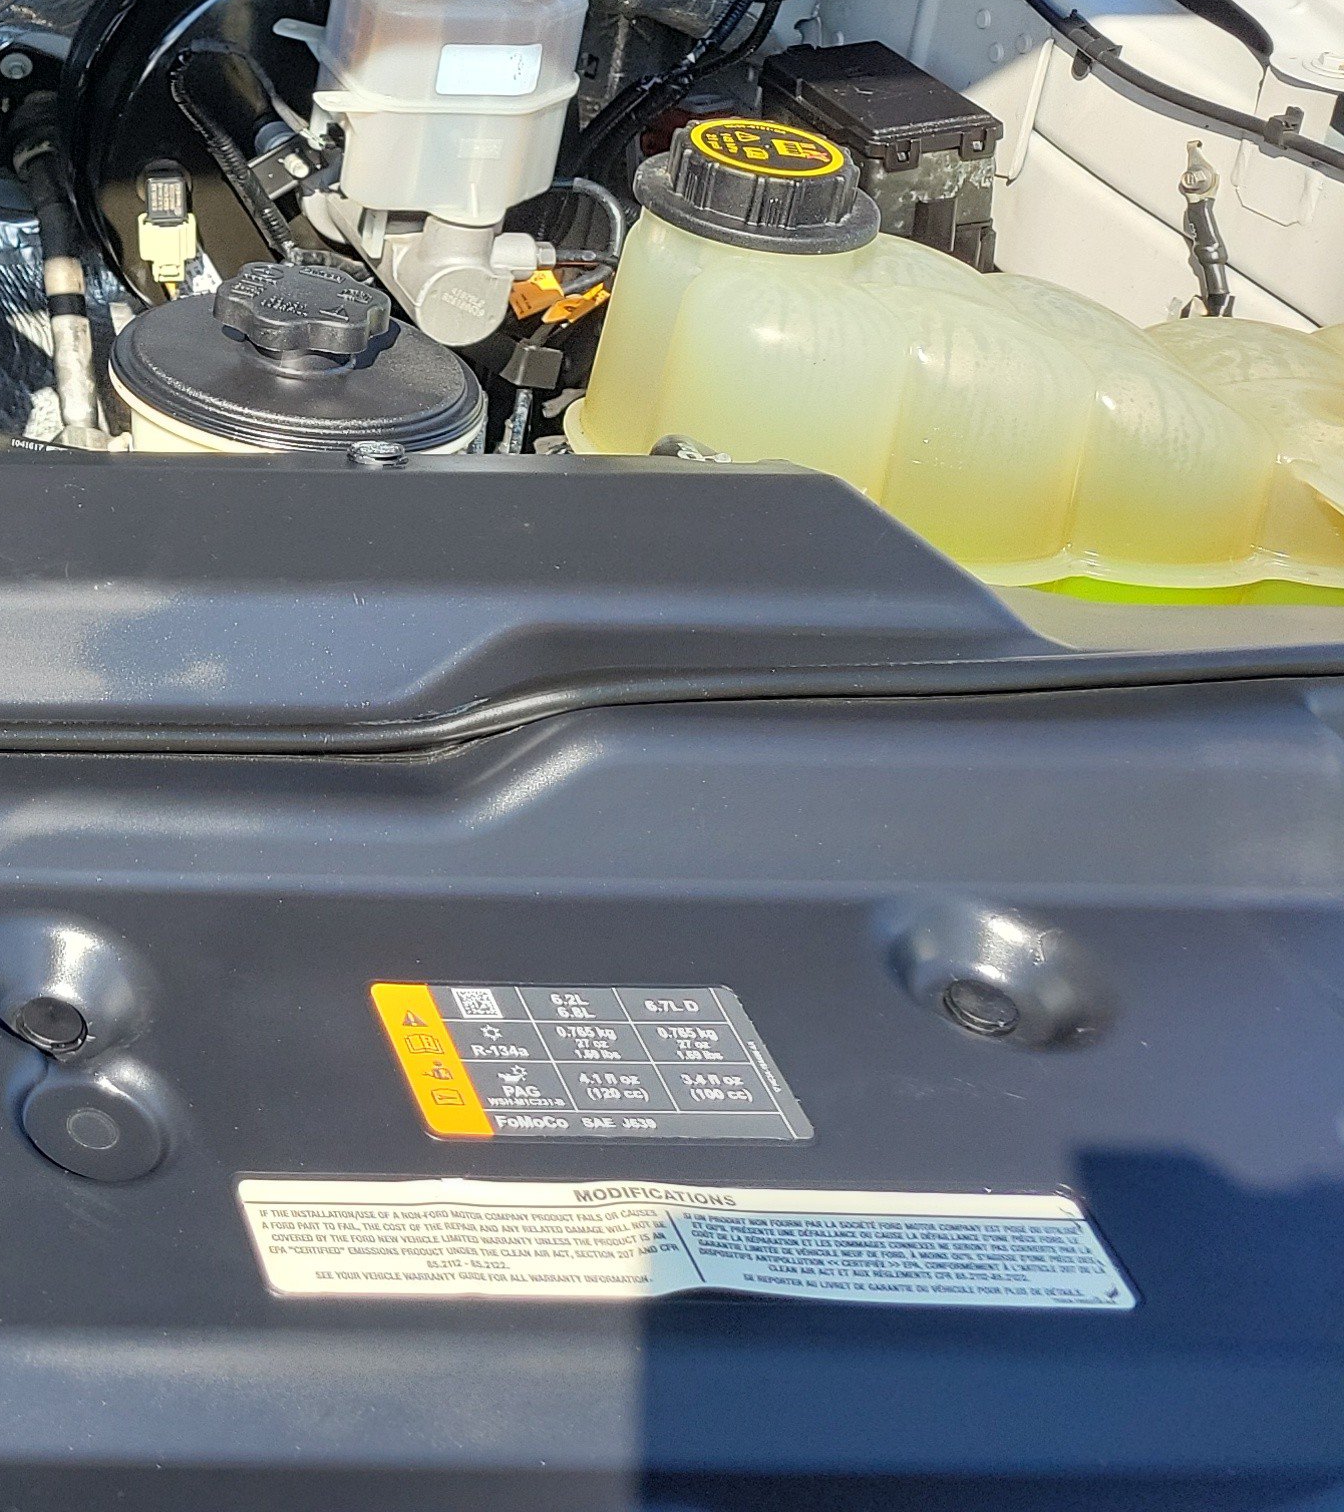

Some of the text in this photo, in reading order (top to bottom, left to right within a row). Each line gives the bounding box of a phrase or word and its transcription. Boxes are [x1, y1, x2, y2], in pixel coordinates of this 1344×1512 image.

[550, 994, 589, 1006] 6.2L
[644, 1000, 699, 1012] 6.7L D
[556, 1026, 617, 1040] 0.765 kg
[657, 1027, 719, 1041] 0.765 kg
[575, 1039, 589, 1048] 27
[676, 1040, 692, 1049] 27
[471, 1045, 529, 1057] R-134a
[580, 1074, 602, 1085] 4.1
[620, 1076, 641, 1085] oz
[680, 1074, 707, 1085] 3.4
[722, 1076, 744, 1086] oz
[502, 1086, 541, 1098] PAG
[587, 1088, 649, 1102] (120 cc)
[690, 1088, 753, 1102] (100 cc)
[494, 1115, 569, 1128] FoMoCo
[581, 1117, 616, 1129] SAE
[573, 1186, 737, 1206] MODIFICATIONS
[260, 1209, 657, 1222] IF THE INSTALLATION/USE OF A NON-FORD MOTOR COMPANY PRODUCT FAILS OR CAUSES
[271, 1222, 294, 1230] FORD
[298, 1222, 320, 1230] PART
[323, 1222, 335, 1230] TO
[338, 1222, 360, 1231] FAIL,
[362, 1223, 380, 1231] THE
[383, 1223, 406, 1232] COST
[410, 1223, 421, 1232] OF
[424, 1223, 442, 1231] THE
[444, 1222, 478, 1231] REPAIR
[480, 1224, 499, 1233] AND
[502, 1225, 519, 1233] ANY
[522, 1225, 563, 1234] RELATED
[565, 1225, 604, 1234] DAMAGE
[608, 1224, 630, 1234] WILL
[632, 1221, 651, 1230] NOT
[272, 1232, 666, 1247] COVERED BY THE FORD NEW VEHICLE LIMITED WARRANTY UNLESS THE PRODUCT IS AN
[269, 1246, 287, 1254] EPA
[348, 1247, 399, 1256] EMISSIONS
[402, 1247, 444, 1256] PRODUCT
[447, 1247, 480, 1256] UNDER
[482, 1248, 499, 1257] THE
[501, 1249, 531, 1258] CLEAN
[534, 1249, 550, 1258] AIR
[553, 1250, 574, 1259] ACT,
[576, 1249, 616, 1259] SECTION
[639, 1245, 657, 1255] AND
[659, 1243, 679, 1252] CFR
[315, 1271, 334, 1280] SEE
[336, 1272, 360, 1280] YOUR
[362, 1272, 401, 1281] VEHICLE
[403, 1272, 456, 1281] WARRANTY
[458, 1272, 487, 1282] GUIDE
[488, 1273, 507, 1282] FOR
[510, 1274, 527, 1282] ALL
[531, 1274, 582, 1283] WARRANTY
